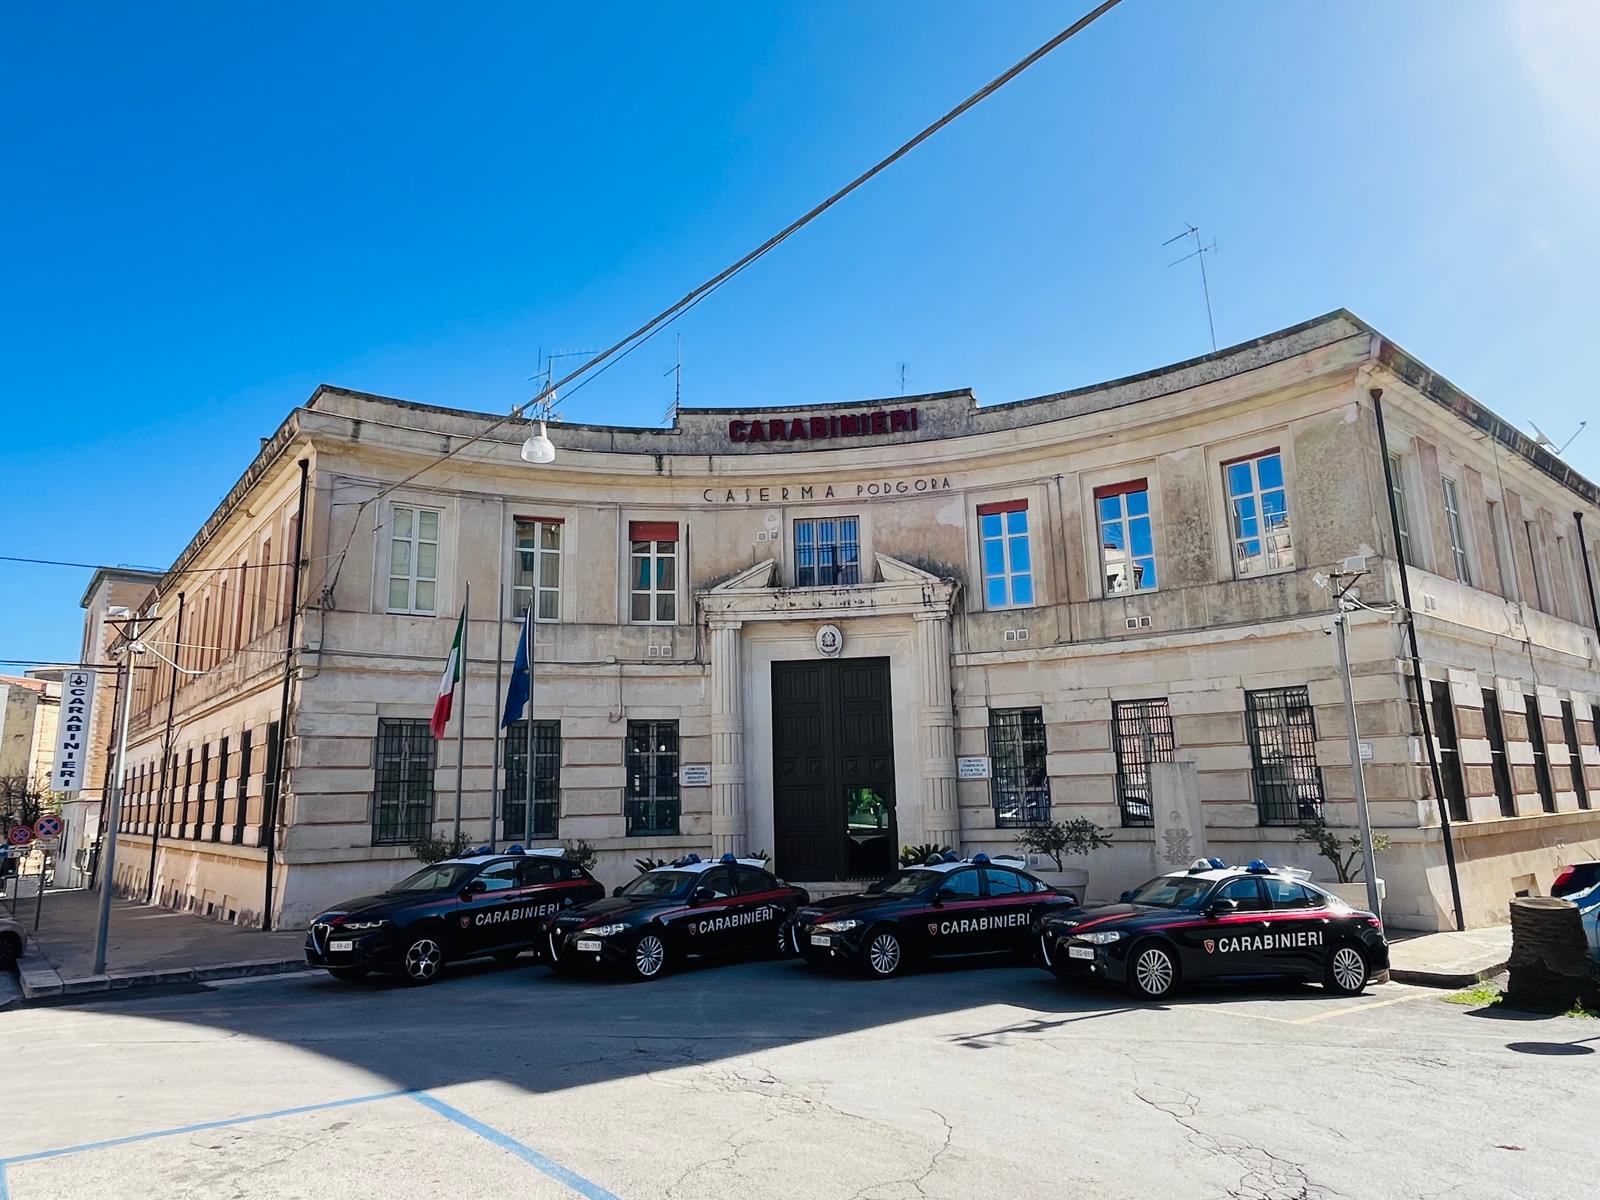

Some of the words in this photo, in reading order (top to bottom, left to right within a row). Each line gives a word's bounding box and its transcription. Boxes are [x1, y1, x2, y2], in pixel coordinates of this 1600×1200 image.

[728, 407, 918, 443] CARABINIERI
[703, 485, 835, 503] CASERMA
[857, 477, 951, 497] PODGORA
[60, 688, 86, 787] CARABINIERI
[475, 903, 561, 926] CARABINIERI
[699, 907, 774, 934] CARABINIERI
[940, 912, 1031, 935] CARABINIERI
[1218, 931, 1324, 953] CARABINIERI
